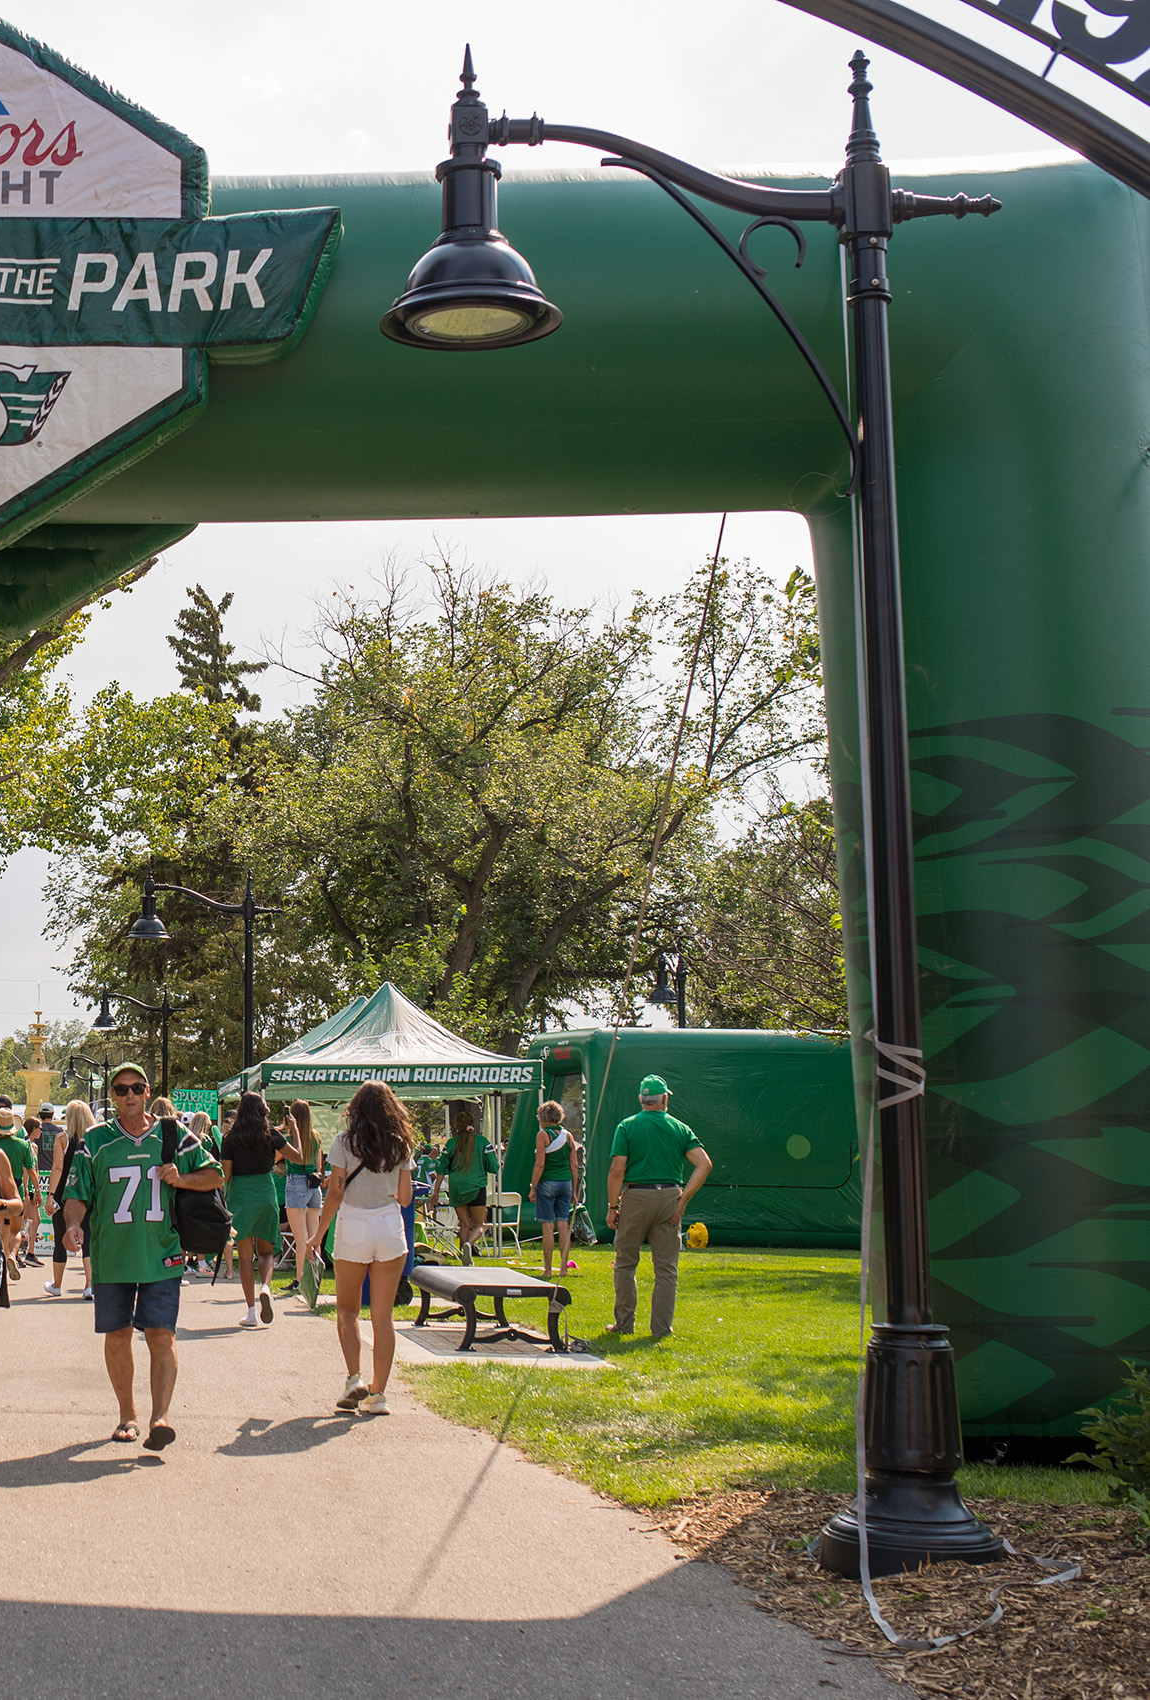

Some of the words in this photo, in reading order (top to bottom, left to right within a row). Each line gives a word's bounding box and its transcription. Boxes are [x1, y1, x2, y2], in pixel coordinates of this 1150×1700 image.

[67, 248, 273, 312] PARK
[270, 1068, 410, 1082] SASKATCHEWAN
[413, 1067, 534, 1083] ROUGHRIDERS
[172, 1091, 216, 1104] SPARKLE
[109, 1165, 165, 1224] 71
